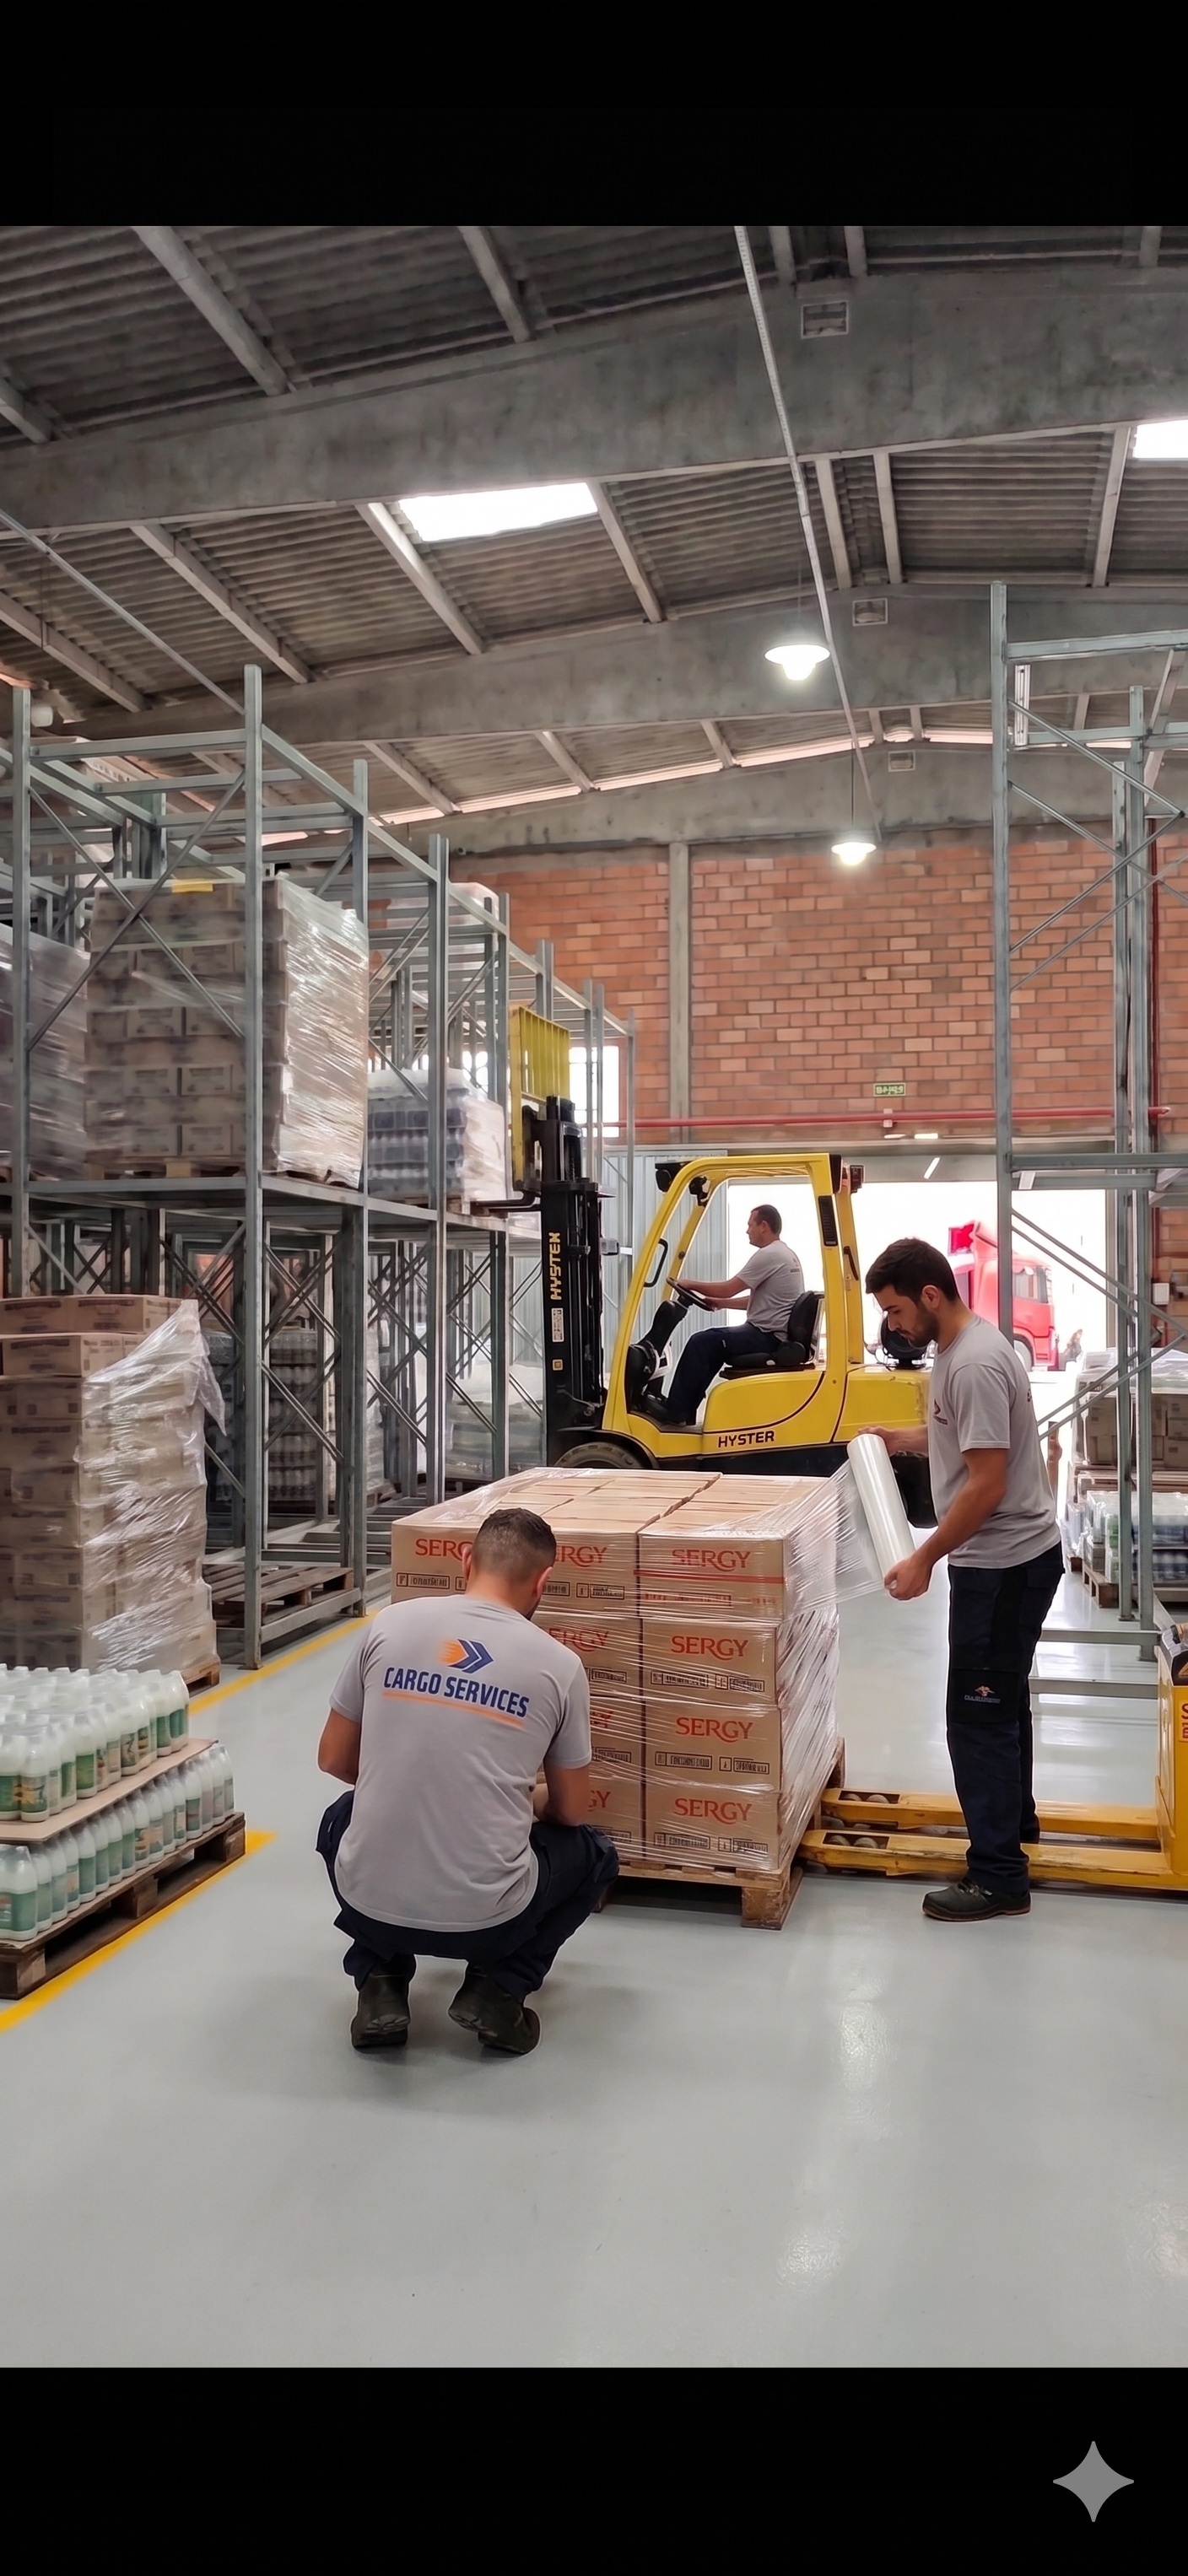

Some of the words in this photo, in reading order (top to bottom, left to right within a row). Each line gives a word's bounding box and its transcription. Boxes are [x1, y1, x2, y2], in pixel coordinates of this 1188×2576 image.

[718, 1431, 775, 1447] HYSTER
[672, 1549, 751, 1571] SERGY
[671, 1636, 748, 1661] SERGY
[384, 1667, 442, 1695] CARGO
[444, 1676, 530, 1718] SERVICES
[676, 1716, 753, 1743] SERGY
[673, 1797, 753, 1825] SERGY
